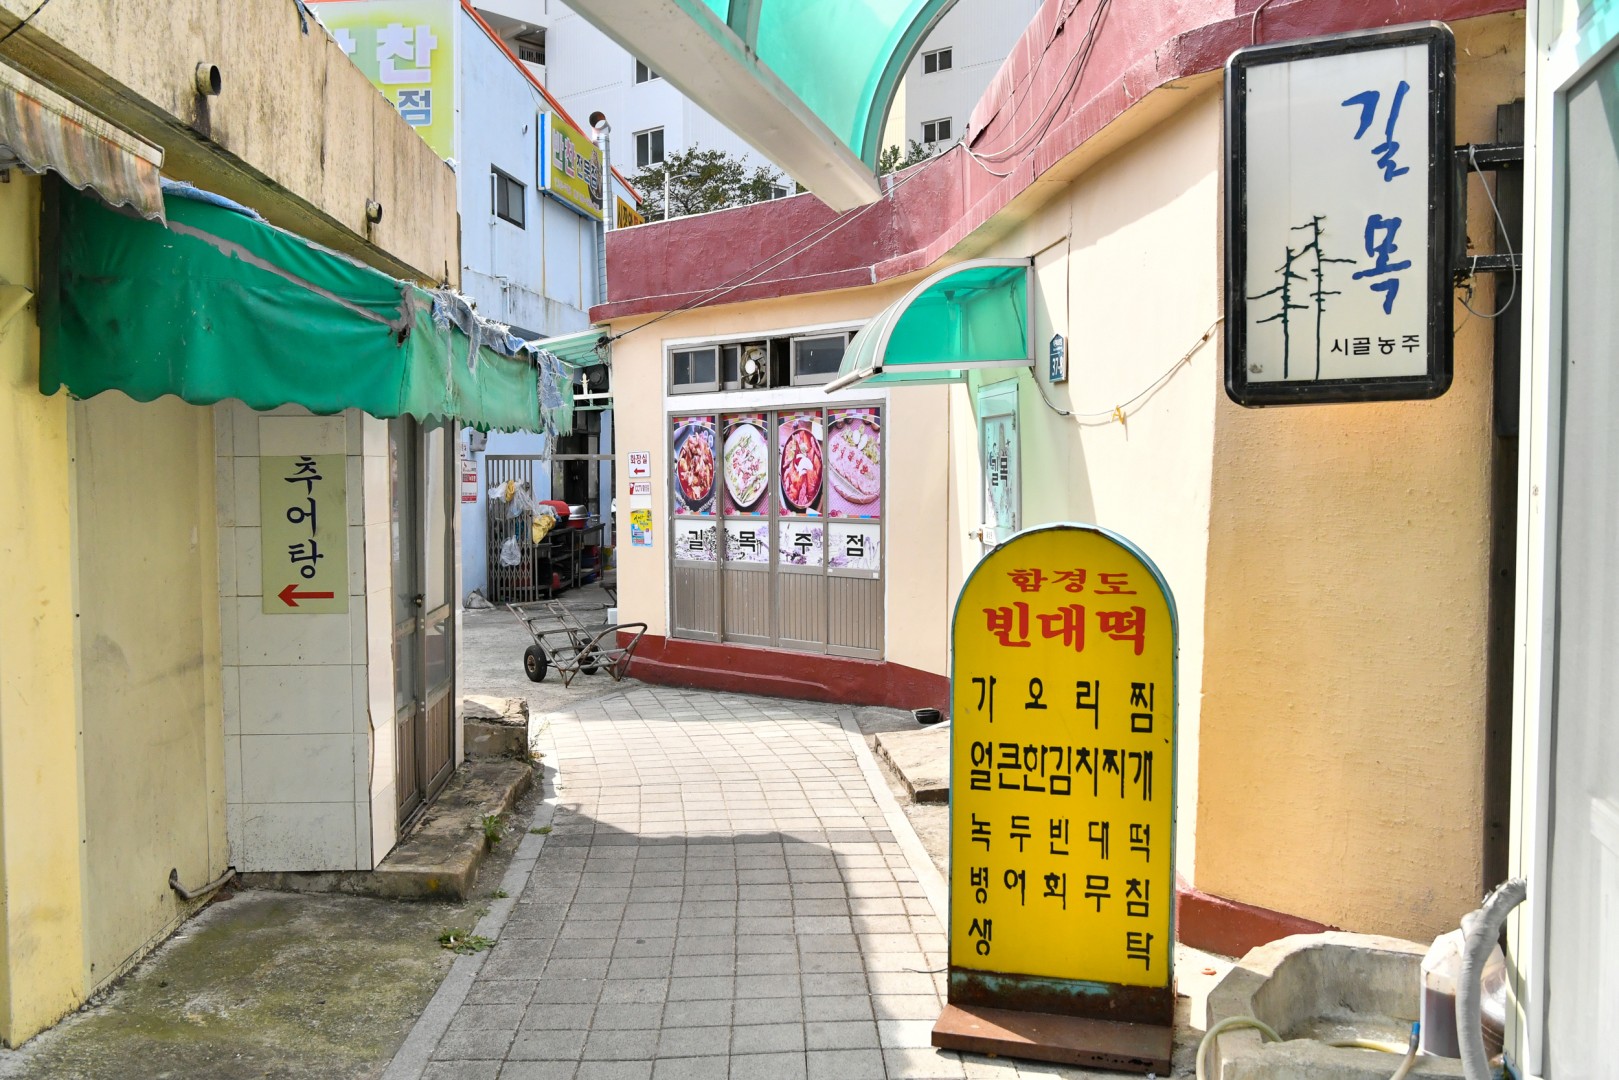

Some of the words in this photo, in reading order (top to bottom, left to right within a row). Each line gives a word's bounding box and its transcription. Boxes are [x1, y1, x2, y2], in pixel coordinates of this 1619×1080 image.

[552, 128, 576, 179] 반찬
[1341, 80, 1411, 315] 길목
[630, 454, 648, 465] 화장실
[284, 456, 324, 579] 추어탕
[982, 601, 1147, 656] 빈대떡
